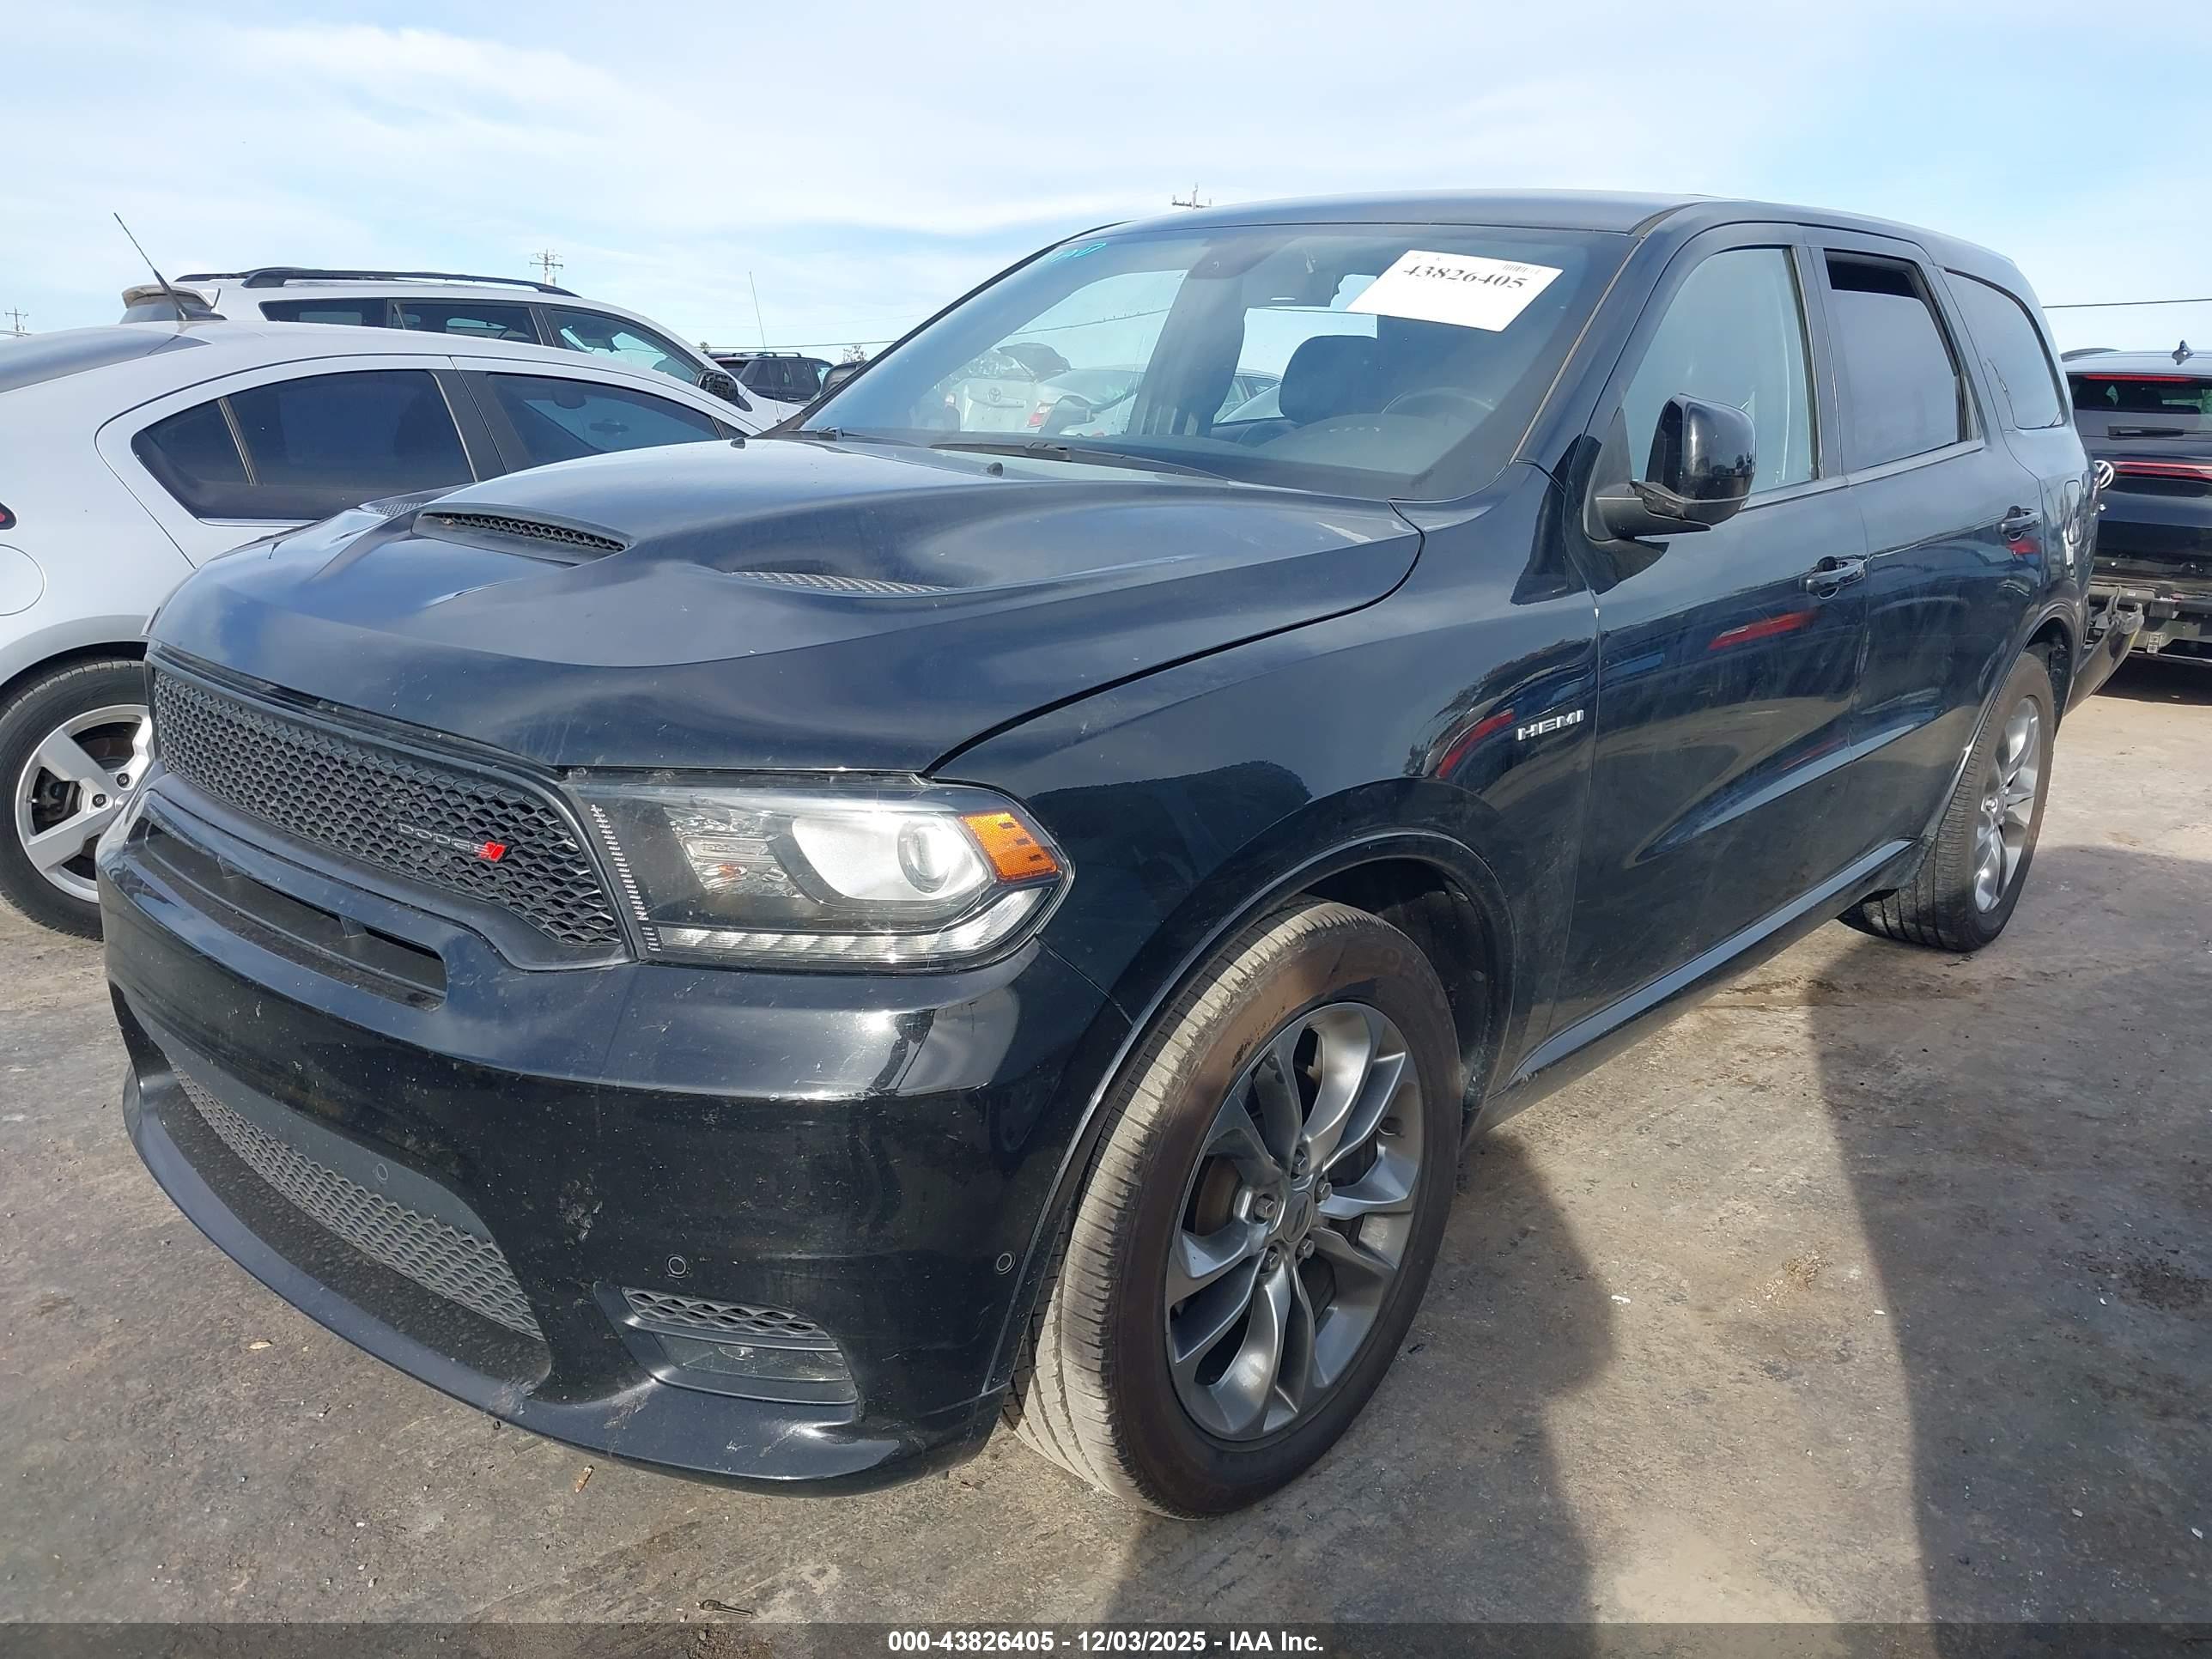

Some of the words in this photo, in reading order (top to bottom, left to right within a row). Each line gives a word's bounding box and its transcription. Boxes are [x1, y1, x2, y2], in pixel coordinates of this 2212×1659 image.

[1403, 264, 1529, 289] 43826405
[1517, 709, 1584, 741] HEMI
[398, 823, 489, 857] DODGE
